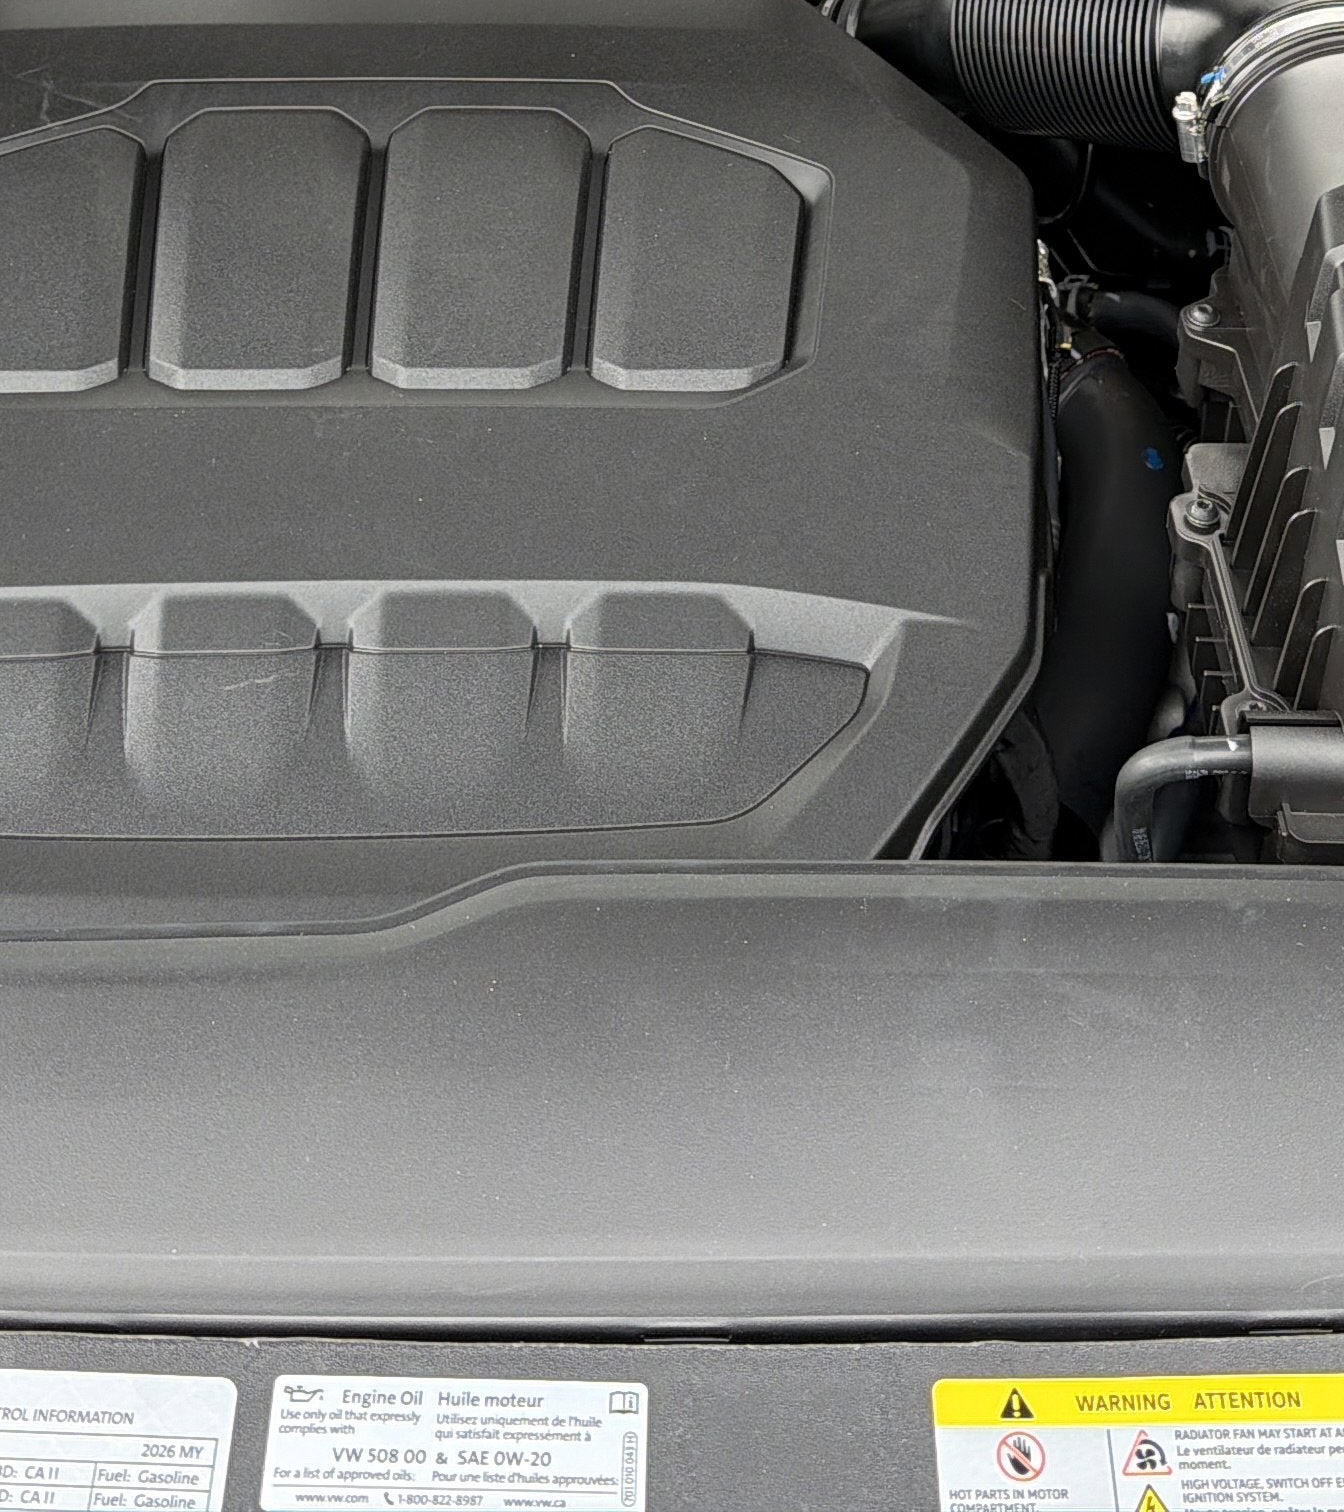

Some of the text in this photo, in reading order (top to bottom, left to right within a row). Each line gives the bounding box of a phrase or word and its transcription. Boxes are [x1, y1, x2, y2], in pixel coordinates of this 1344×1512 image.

[342, 1389, 423, 1408] Engine Oil
[438, 1392, 544, 1408] Huile moteur
[1076, 1391, 1302, 1412] WARNING ATTENTION
[33, 1408, 135, 1425] INFORMATION
[280, 1408, 421, 1426] Use only oil that expressly
[437, 1412, 603, 1429] Utilisez uniquement de l'huile
[279, 1424, 355, 1436] complies with
[434, 1427, 454, 1441] qui
[456, 1428, 500, 1440] satisfait
[502, 1429, 581, 1443] expressément
[1174, 1428, 1230, 1440] RADIATOR
[1233, 1428, 1255, 1440] FAN
[1258, 1428, 1281, 1439] MAY
[1283, 1427, 1316, 1439] START
[1319, 1427, 1333, 1438] AT
[141, 1443, 204, 1459] 2026 MY
[332, 1447, 552, 1467] VW 508 00 & SAE 0W-20
[1176, 1445, 1190, 1456] Le
[1193, 1444, 1255, 1456] ventilateur
[1257, 1444, 1272, 1455] de
[1274, 1443, 1325, 1455] radiateur
[1178, 1459, 1232, 1470] moment.
[24, 1466, 45, 1480] CA
[97, 1468, 200, 1486] Fuel: Gasoline
[273, 1467, 416, 1482] For a list of approved oils:
[432, 1471, 620, 1488] Pour une liste d'huiles approuvées:
[1181, 1479, 1209, 1491] HIGH
[1211, 1479, 1264, 1491] VOLTAGE,
[1265, 1478, 1309, 1489] SWITCH
[1311, 1477, 1333, 1488] OFF
[20, 1489, 40, 1504] CA
[93, 1492, 196, 1510] Fuel: Gasoline
[295, 1493, 369, 1504] www.vw.com
[503, 1496, 567, 1508] www.vw.ca
[949, 1489, 1069, 1500] HOT PARTS IN MOTOR
[1183, 1491, 1284, 1503] IGNITION SYSTEM.
